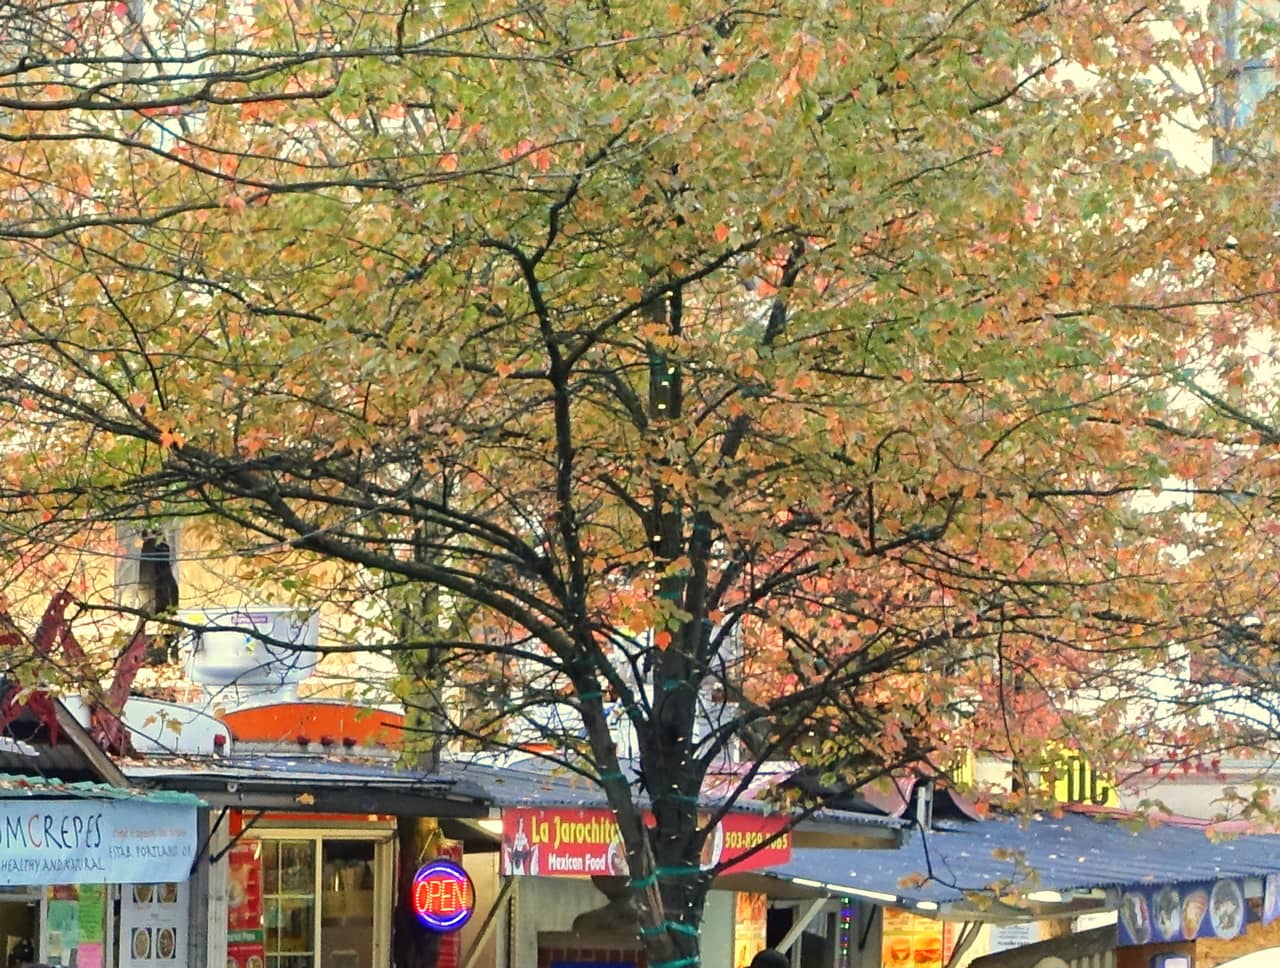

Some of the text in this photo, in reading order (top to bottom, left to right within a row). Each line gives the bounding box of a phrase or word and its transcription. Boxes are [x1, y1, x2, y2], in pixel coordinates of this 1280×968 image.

[530, 815, 550, 843] La
[547, 853, 607, 872] Mexican Food
[415, 878, 467, 913] OPEN
